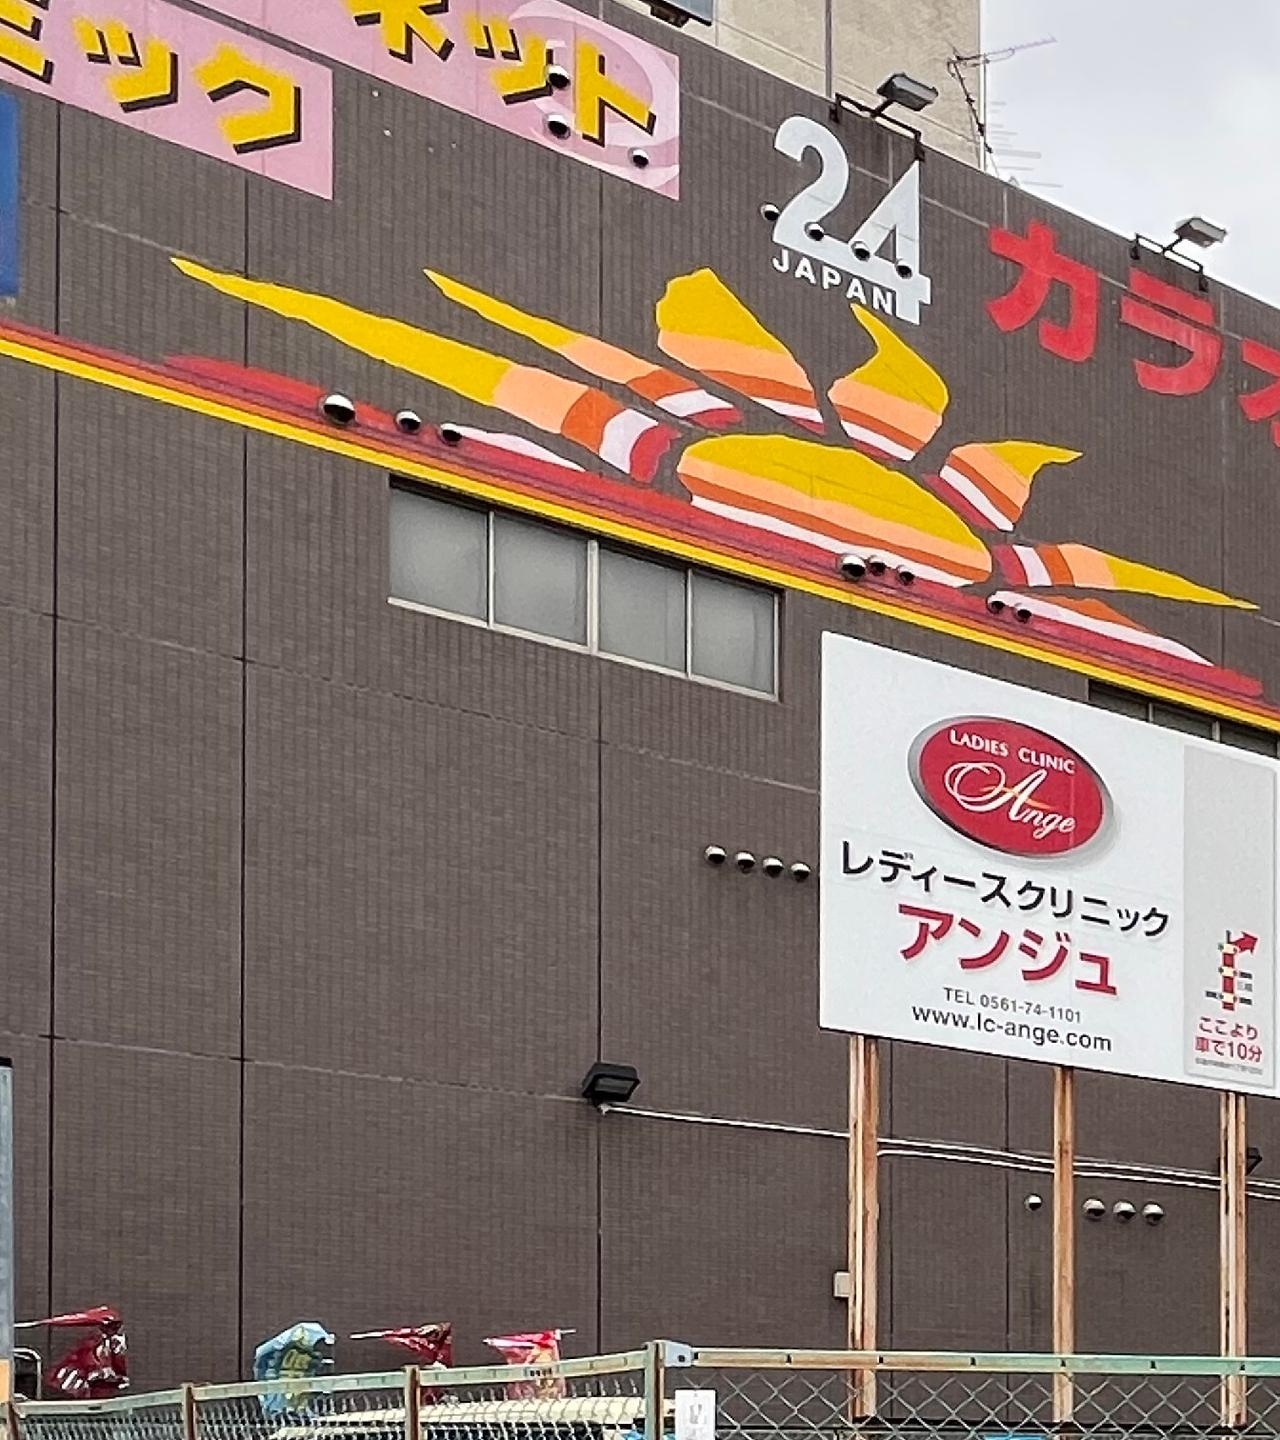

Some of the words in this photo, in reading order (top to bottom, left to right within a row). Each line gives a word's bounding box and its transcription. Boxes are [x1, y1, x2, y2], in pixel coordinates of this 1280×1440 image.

[773, 116, 931, 325] 24
[772, 249, 894, 315] JAPAN
[950, 729, 1009, 757] LADIES
[1018, 747, 1076, 774] CLINIC
[945, 761, 1077, 840] Ange
[842, 840, 1170, 937] レディースクリニック
[898, 903, 1118, 996] アンジュ
[912, 1006, 1112, 1052] www.lc-ange.com
[943, 986, 976, 1006] TEL
[980, 992, 1082, 1024] 0561-74-1101
[1199, 1016, 1258, 1040] ここより
